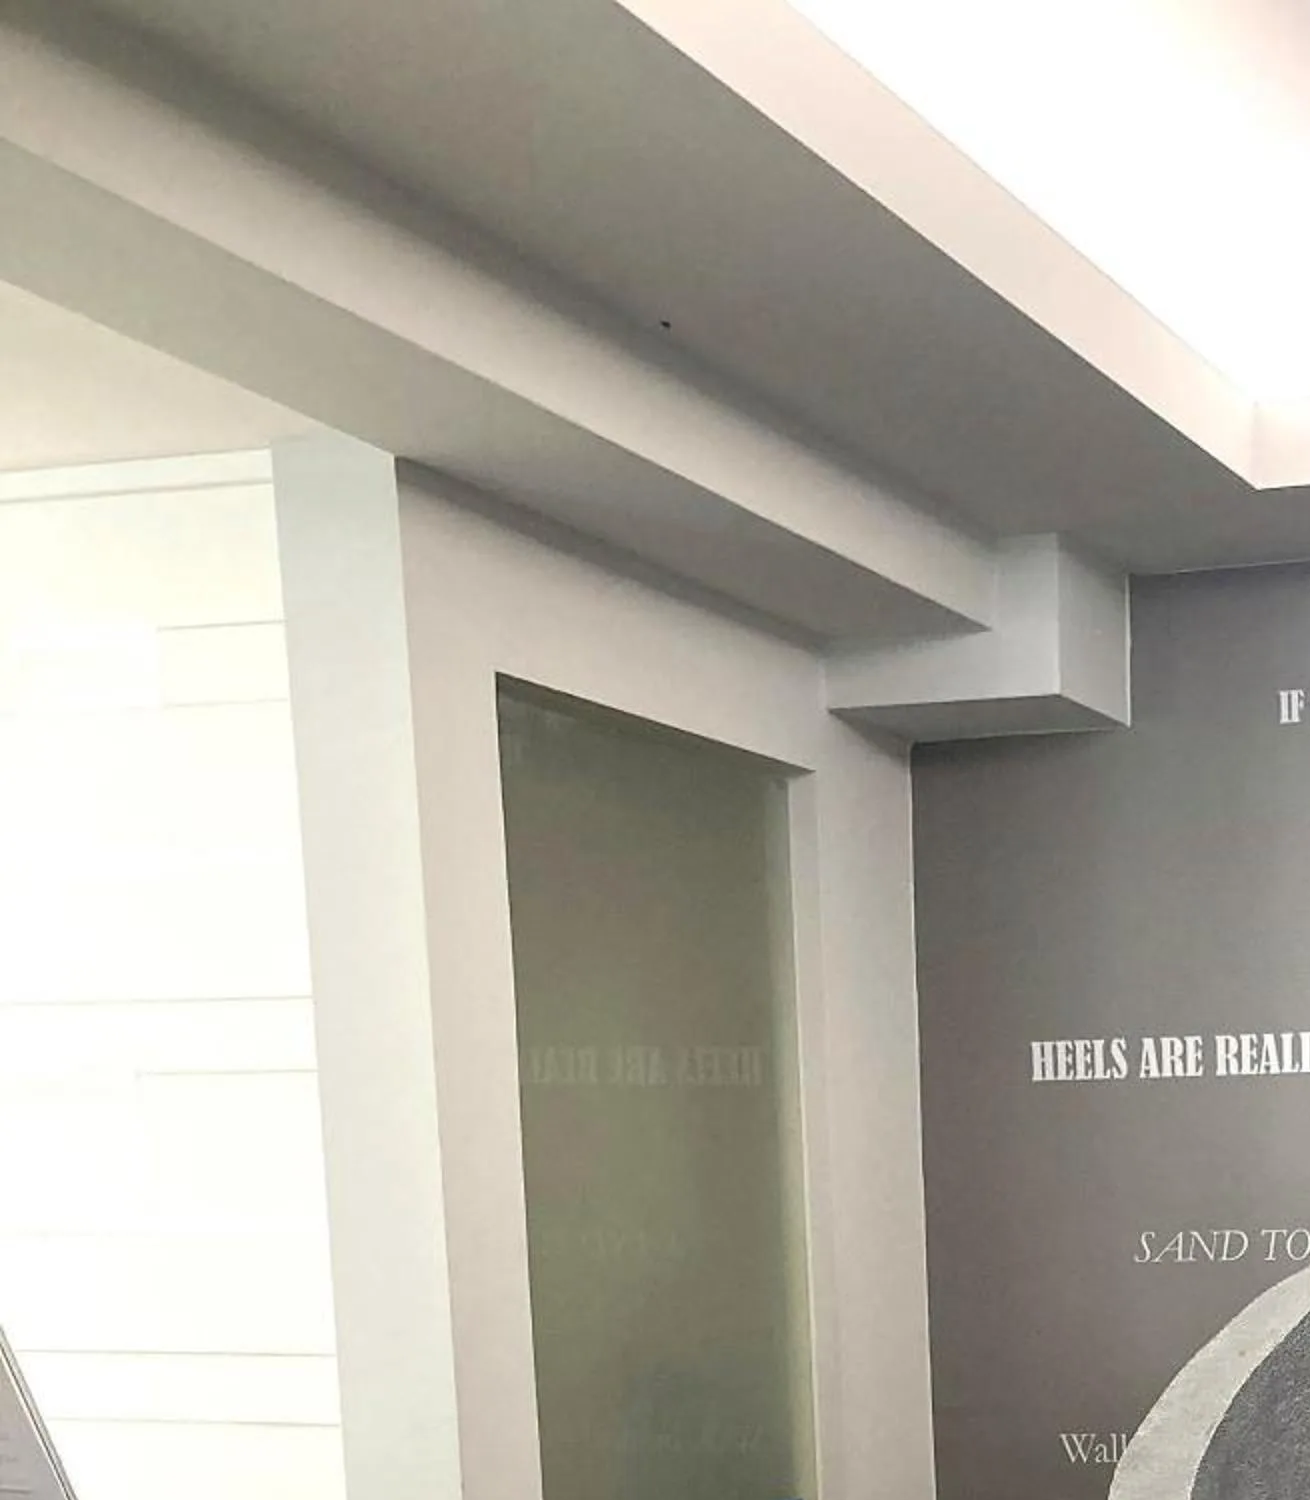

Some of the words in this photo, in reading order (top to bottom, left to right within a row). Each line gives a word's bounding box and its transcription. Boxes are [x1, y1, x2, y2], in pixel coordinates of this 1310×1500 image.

[1279, 690, 1304, 724] IF
[1031, 1038, 1127, 1081] HEELS
[1139, 1035, 1204, 1078] ARE
[1135, 1229, 1249, 1263] SAND
